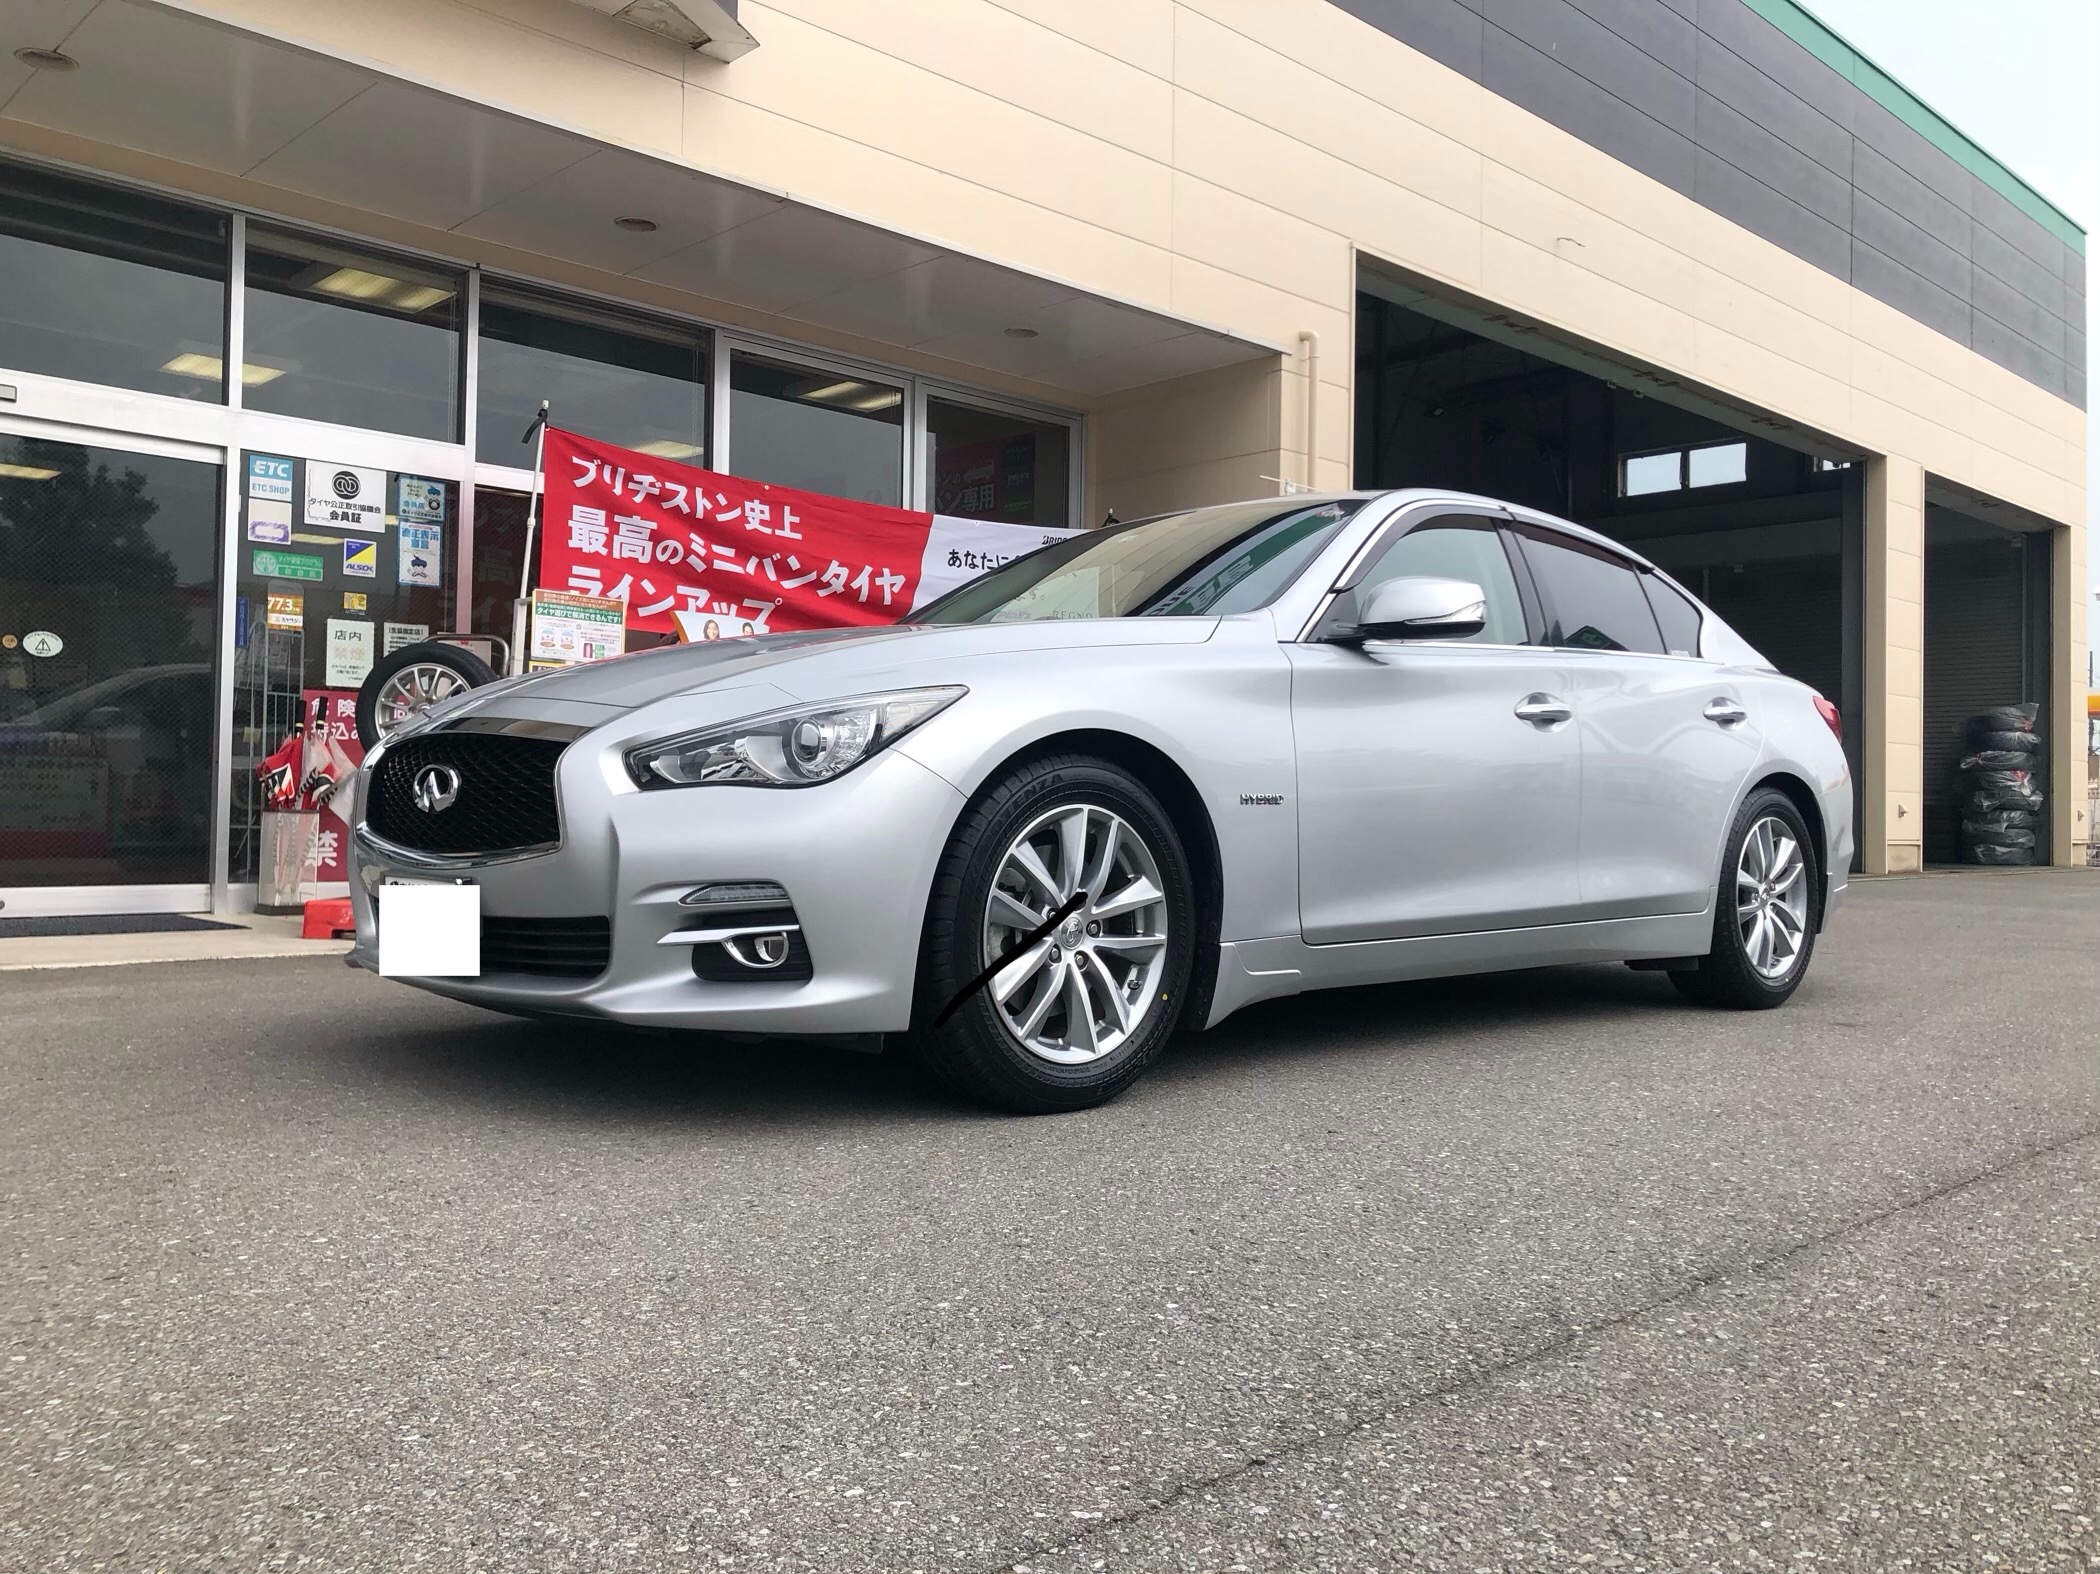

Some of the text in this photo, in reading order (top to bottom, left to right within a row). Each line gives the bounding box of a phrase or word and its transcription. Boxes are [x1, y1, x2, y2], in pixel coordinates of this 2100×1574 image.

[254, 460, 289, 478] ETC
[252, 483, 290, 495] ETC SHOP
[571, 456, 802, 541] ブリヂストン史上
[329, 509, 362, 524] 会員証
[567, 505, 907, 606] 最高のミニバンタイヤ
[346, 563, 374, 573] ALSOK
[335, 630, 362, 641] 店内
[1240, 793, 1284, 805] HYBRID
